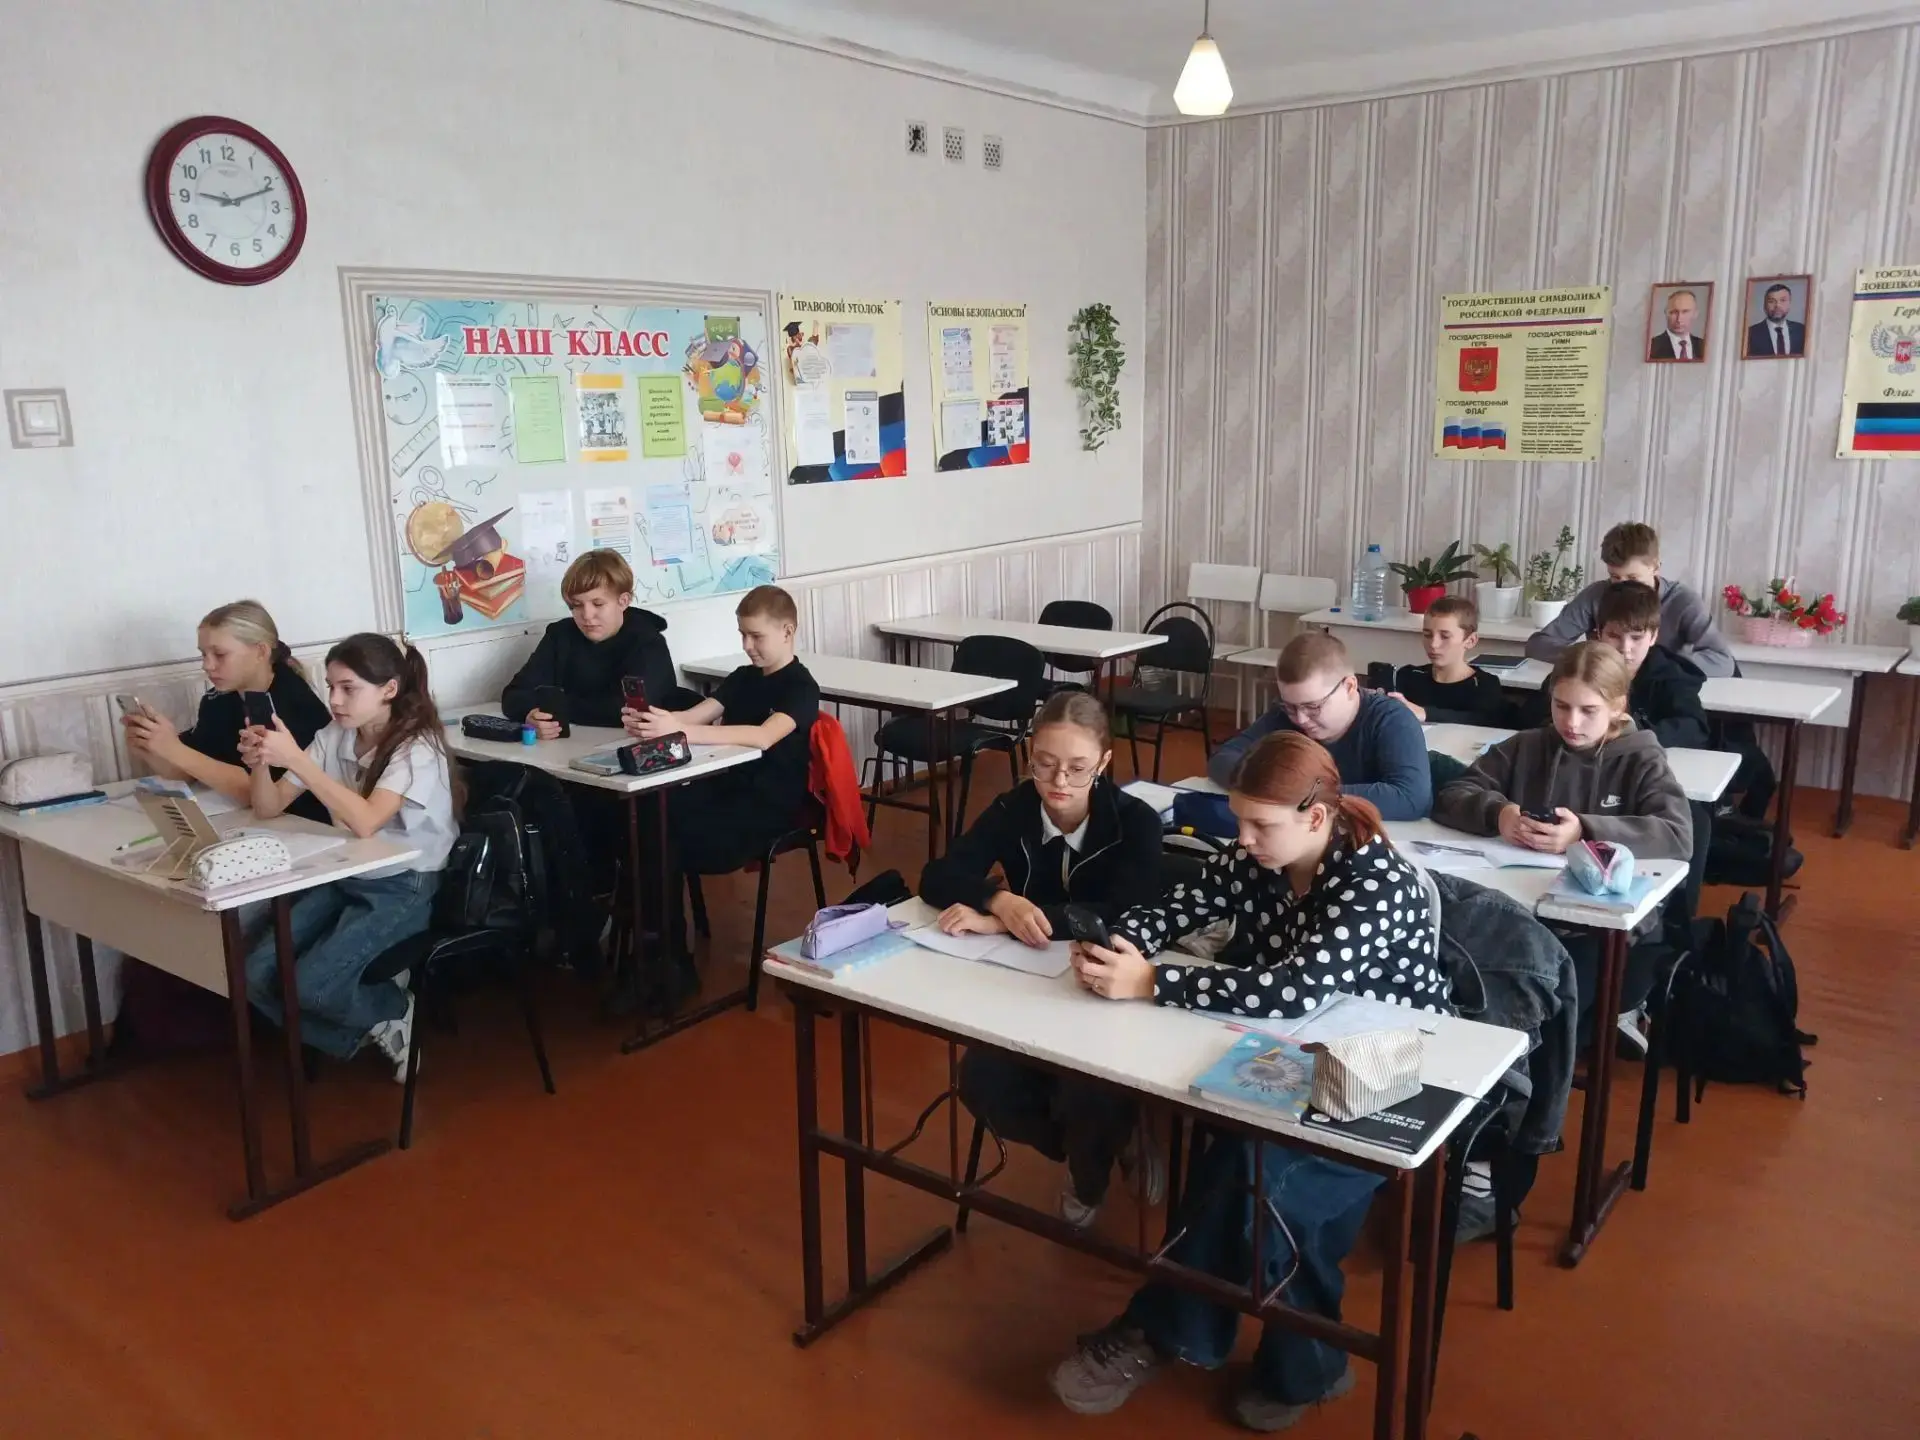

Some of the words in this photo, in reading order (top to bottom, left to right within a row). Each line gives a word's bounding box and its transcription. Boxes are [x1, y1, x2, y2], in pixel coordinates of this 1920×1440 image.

[200, 148, 211, 164] 11
[220, 145, 235, 161] 12
[248, 156, 254, 170] 1
[182, 164, 197, 180] 10
[263, 175, 272, 190] 2
[179, 188, 190, 203] 9
[271, 200, 281, 214] 3
[188, 214, 199, 228] 8
[267, 223, 277, 237] 4
[205, 233, 217, 248] 7
[252, 238, 262, 252] 5
[230, 242, 241, 256] 6
[1861, 281, 1920, 291] ДОНЕЦКО
[793, 299, 845, 313] ПРАВОВОЙ
[847, 303, 884, 314] УГОЛОК
[1447, 296, 1536, 308] ГОСУДАРСТВЕННАЯ
[1538, 291, 1601, 303] СИМВОЛИКА
[930, 306, 964, 317] ОСНОВЫ
[966, 307, 1025, 318] БЕЗОПАСНОСТИ
[1459, 307, 1522, 319] РОССИЙСКОЙ
[1525, 306, 1586, 317] ФЕДЕРАЦИИ
[1448, 332, 1513, 341] ГОСУДАРСТВЕННЫЙ
[1528, 329, 1598, 339] ГОСУДАРСТВЕННЫЙ
[463, 327, 554, 356] НАШ
[566, 328, 669, 357] КЛАСС
[1883, 387, 1914, 397] Флаг
[1464, 407, 1487, 415] ФЛАГ
